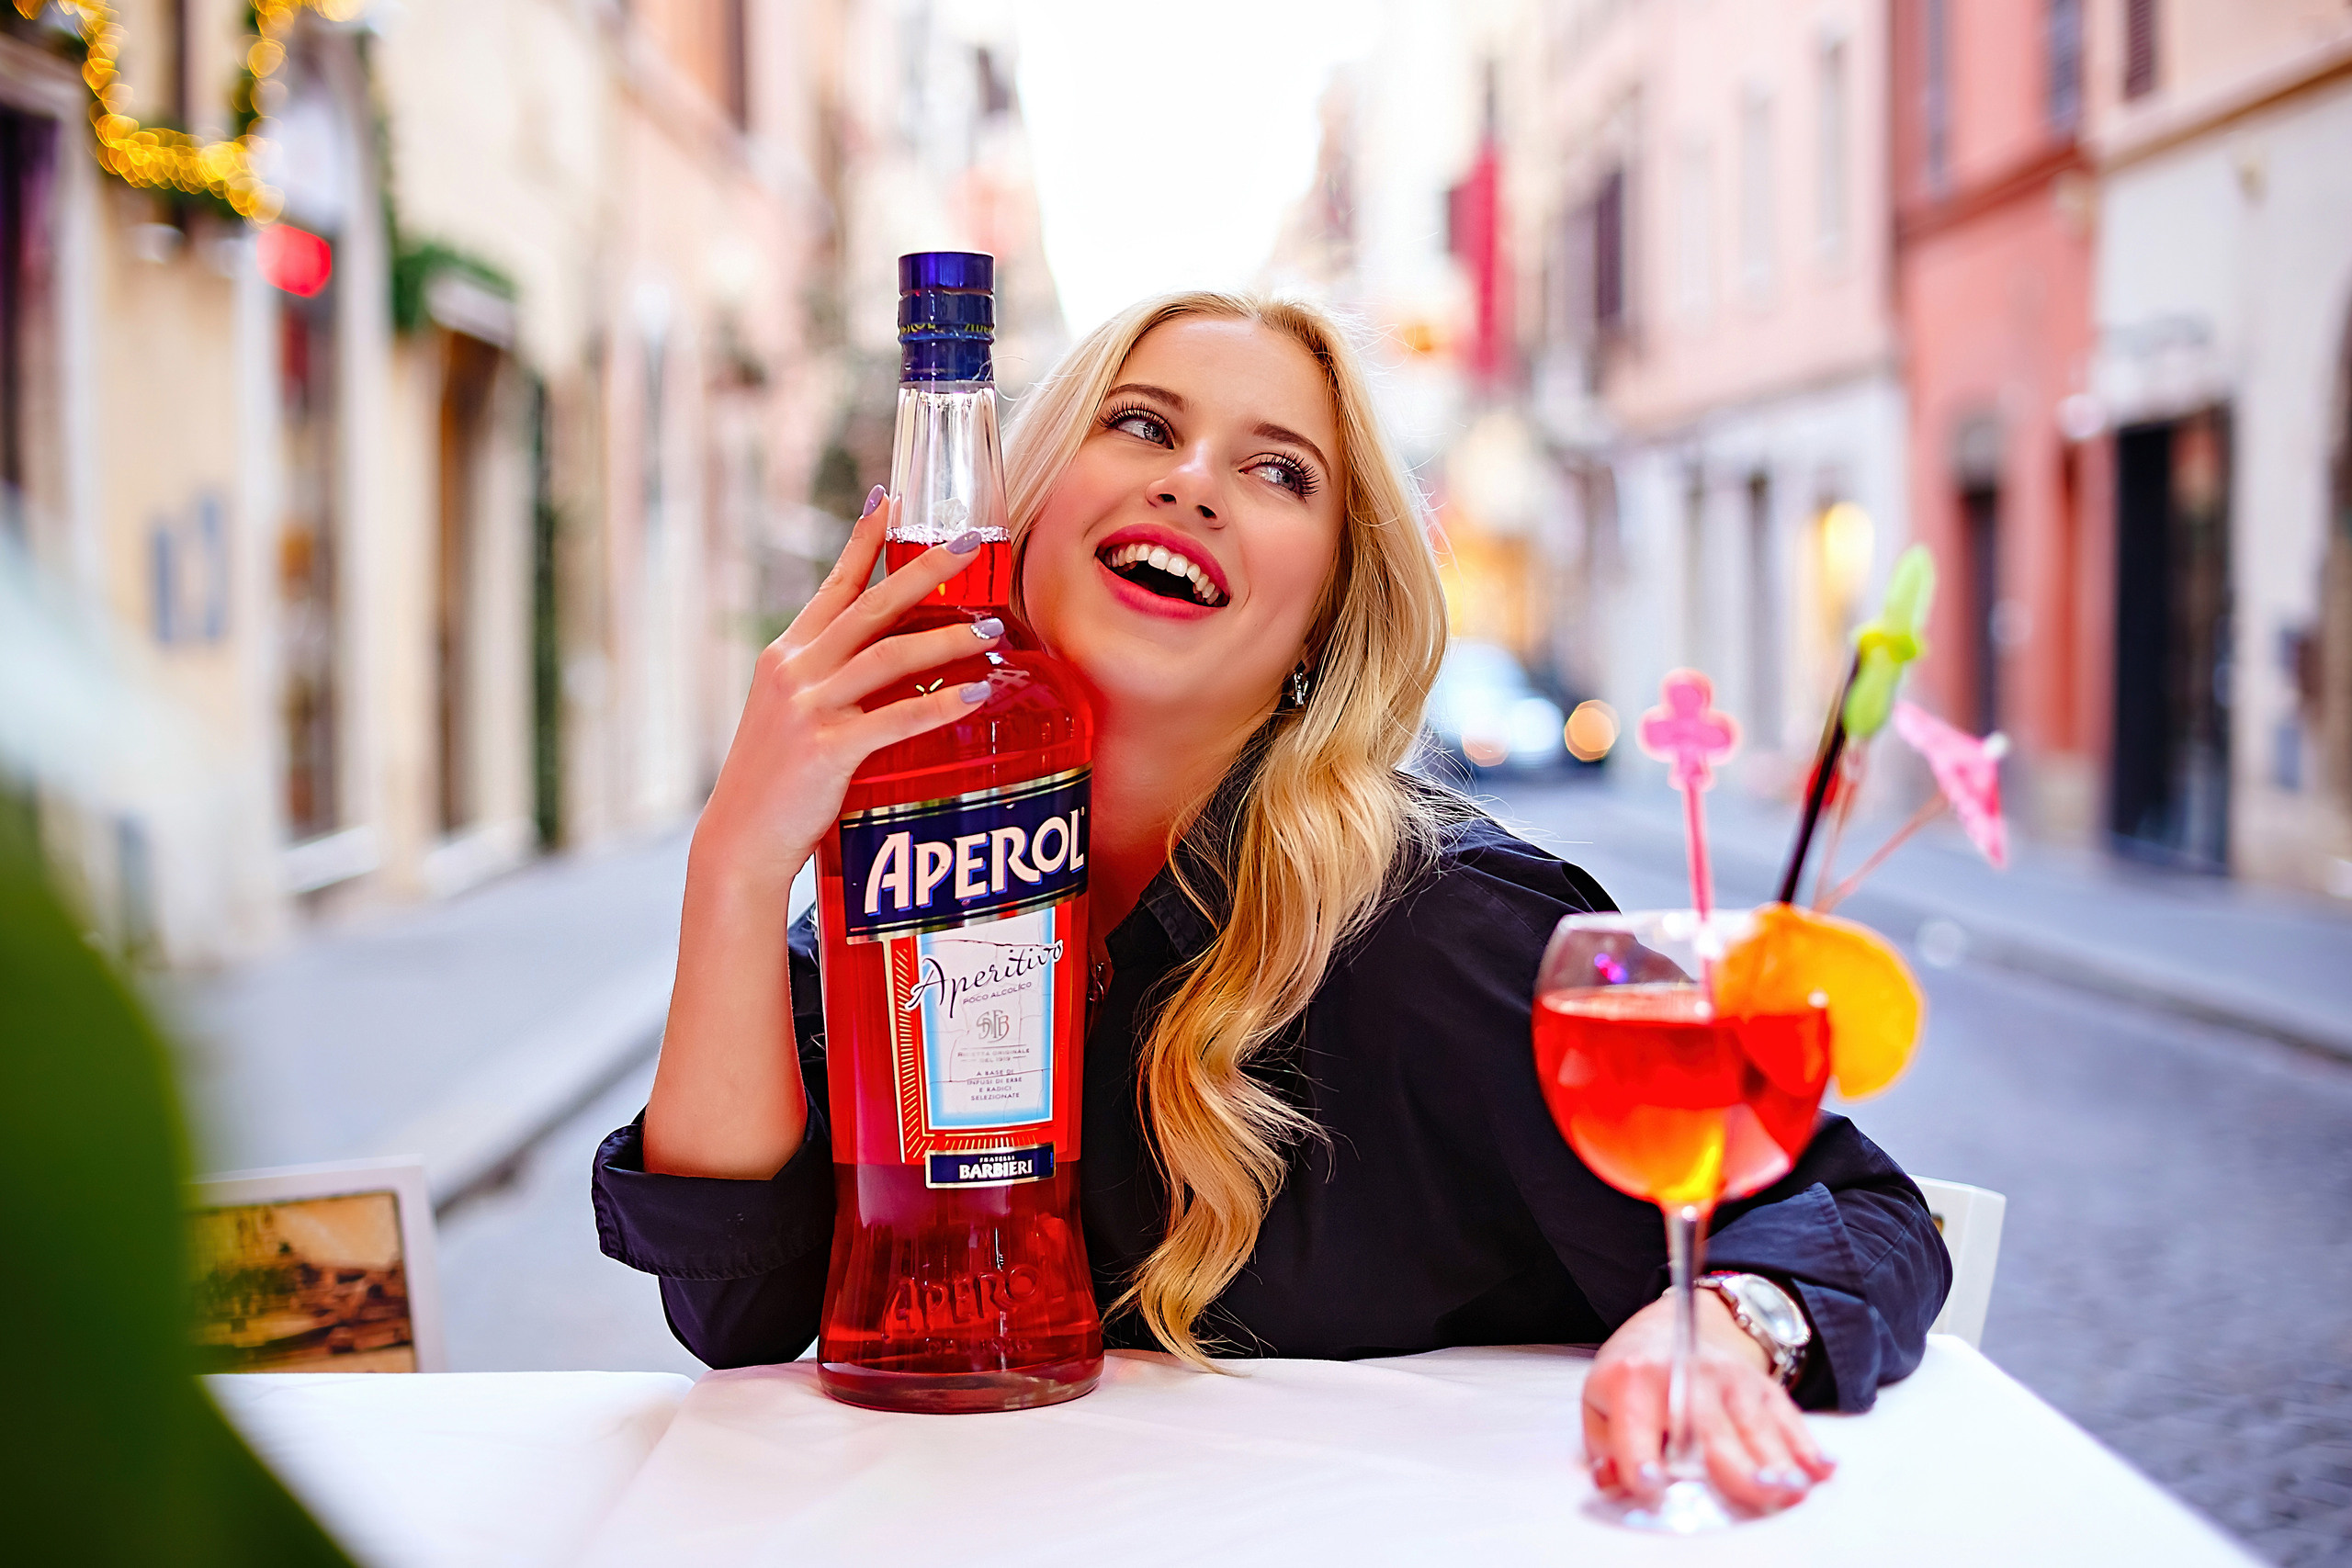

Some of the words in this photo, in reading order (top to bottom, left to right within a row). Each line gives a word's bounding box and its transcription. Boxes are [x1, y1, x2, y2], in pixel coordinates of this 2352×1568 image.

[865, 808, 1084, 915] APEROL
[908, 943, 1063, 1019] Aperitivo
[963, 993, 989, 1005] POCO
[990, 981, 1032, 998] ALCOLICO
[970, 1092, 1020, 1100] SELEZIONATE
[958, 1159, 1033, 1179] BARBIERI
